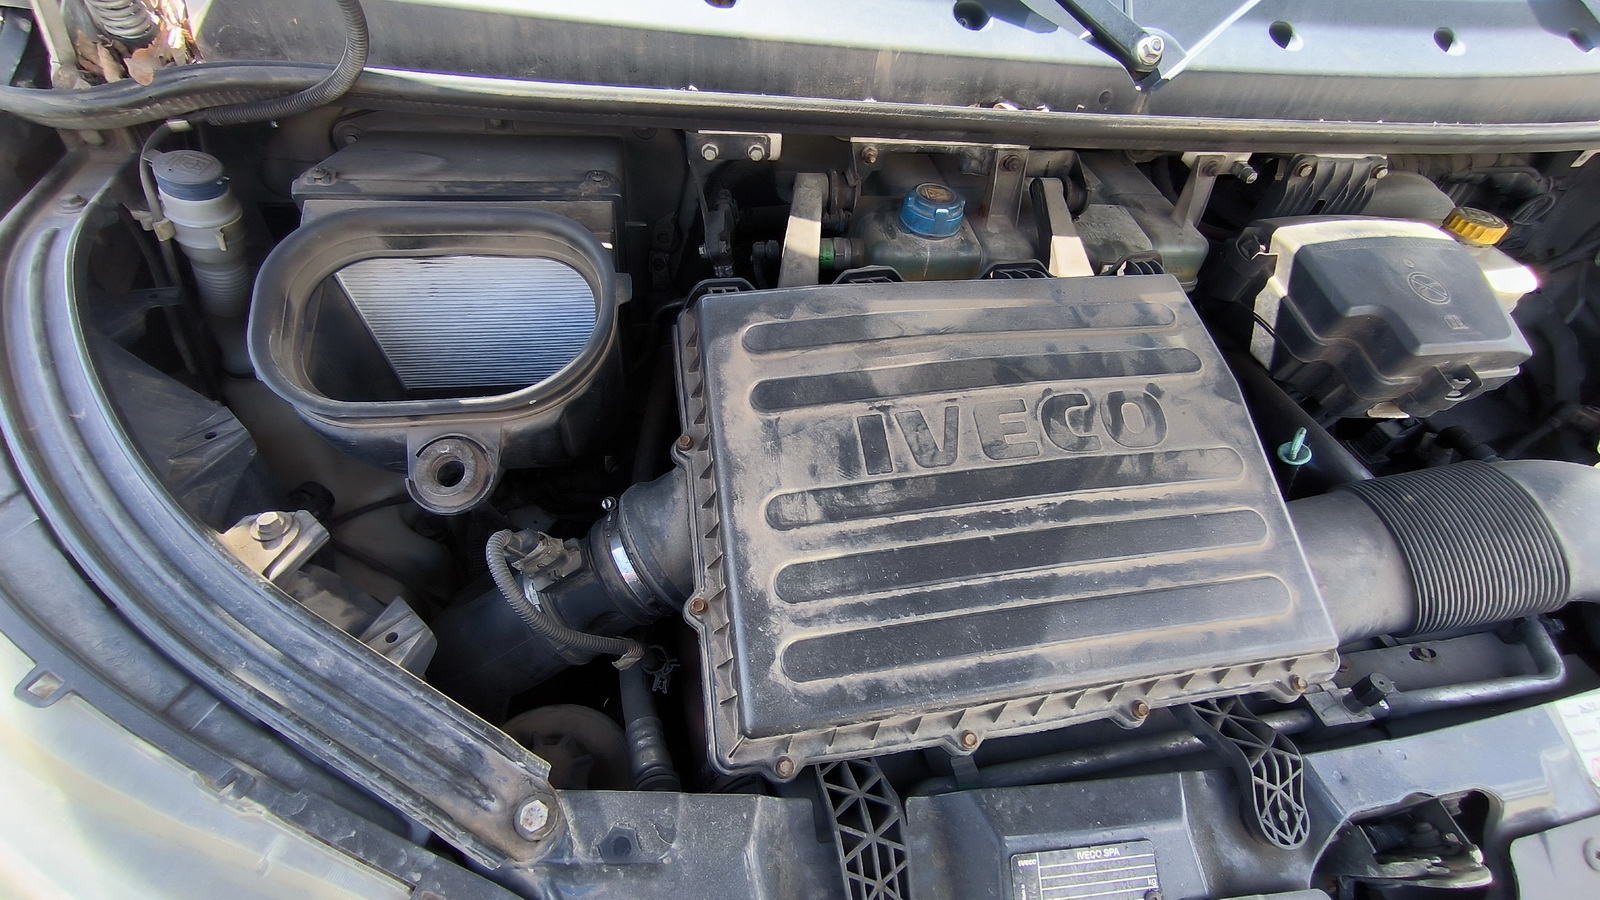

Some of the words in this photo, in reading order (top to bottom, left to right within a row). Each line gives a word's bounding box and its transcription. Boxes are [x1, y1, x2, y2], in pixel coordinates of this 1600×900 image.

[856, 390, 1168, 476] IVECO
[1076, 850, 1102, 860] IVECO
[1103, 847, 1121, 857] SPA
[1147, 877, 1157, 887] kg
